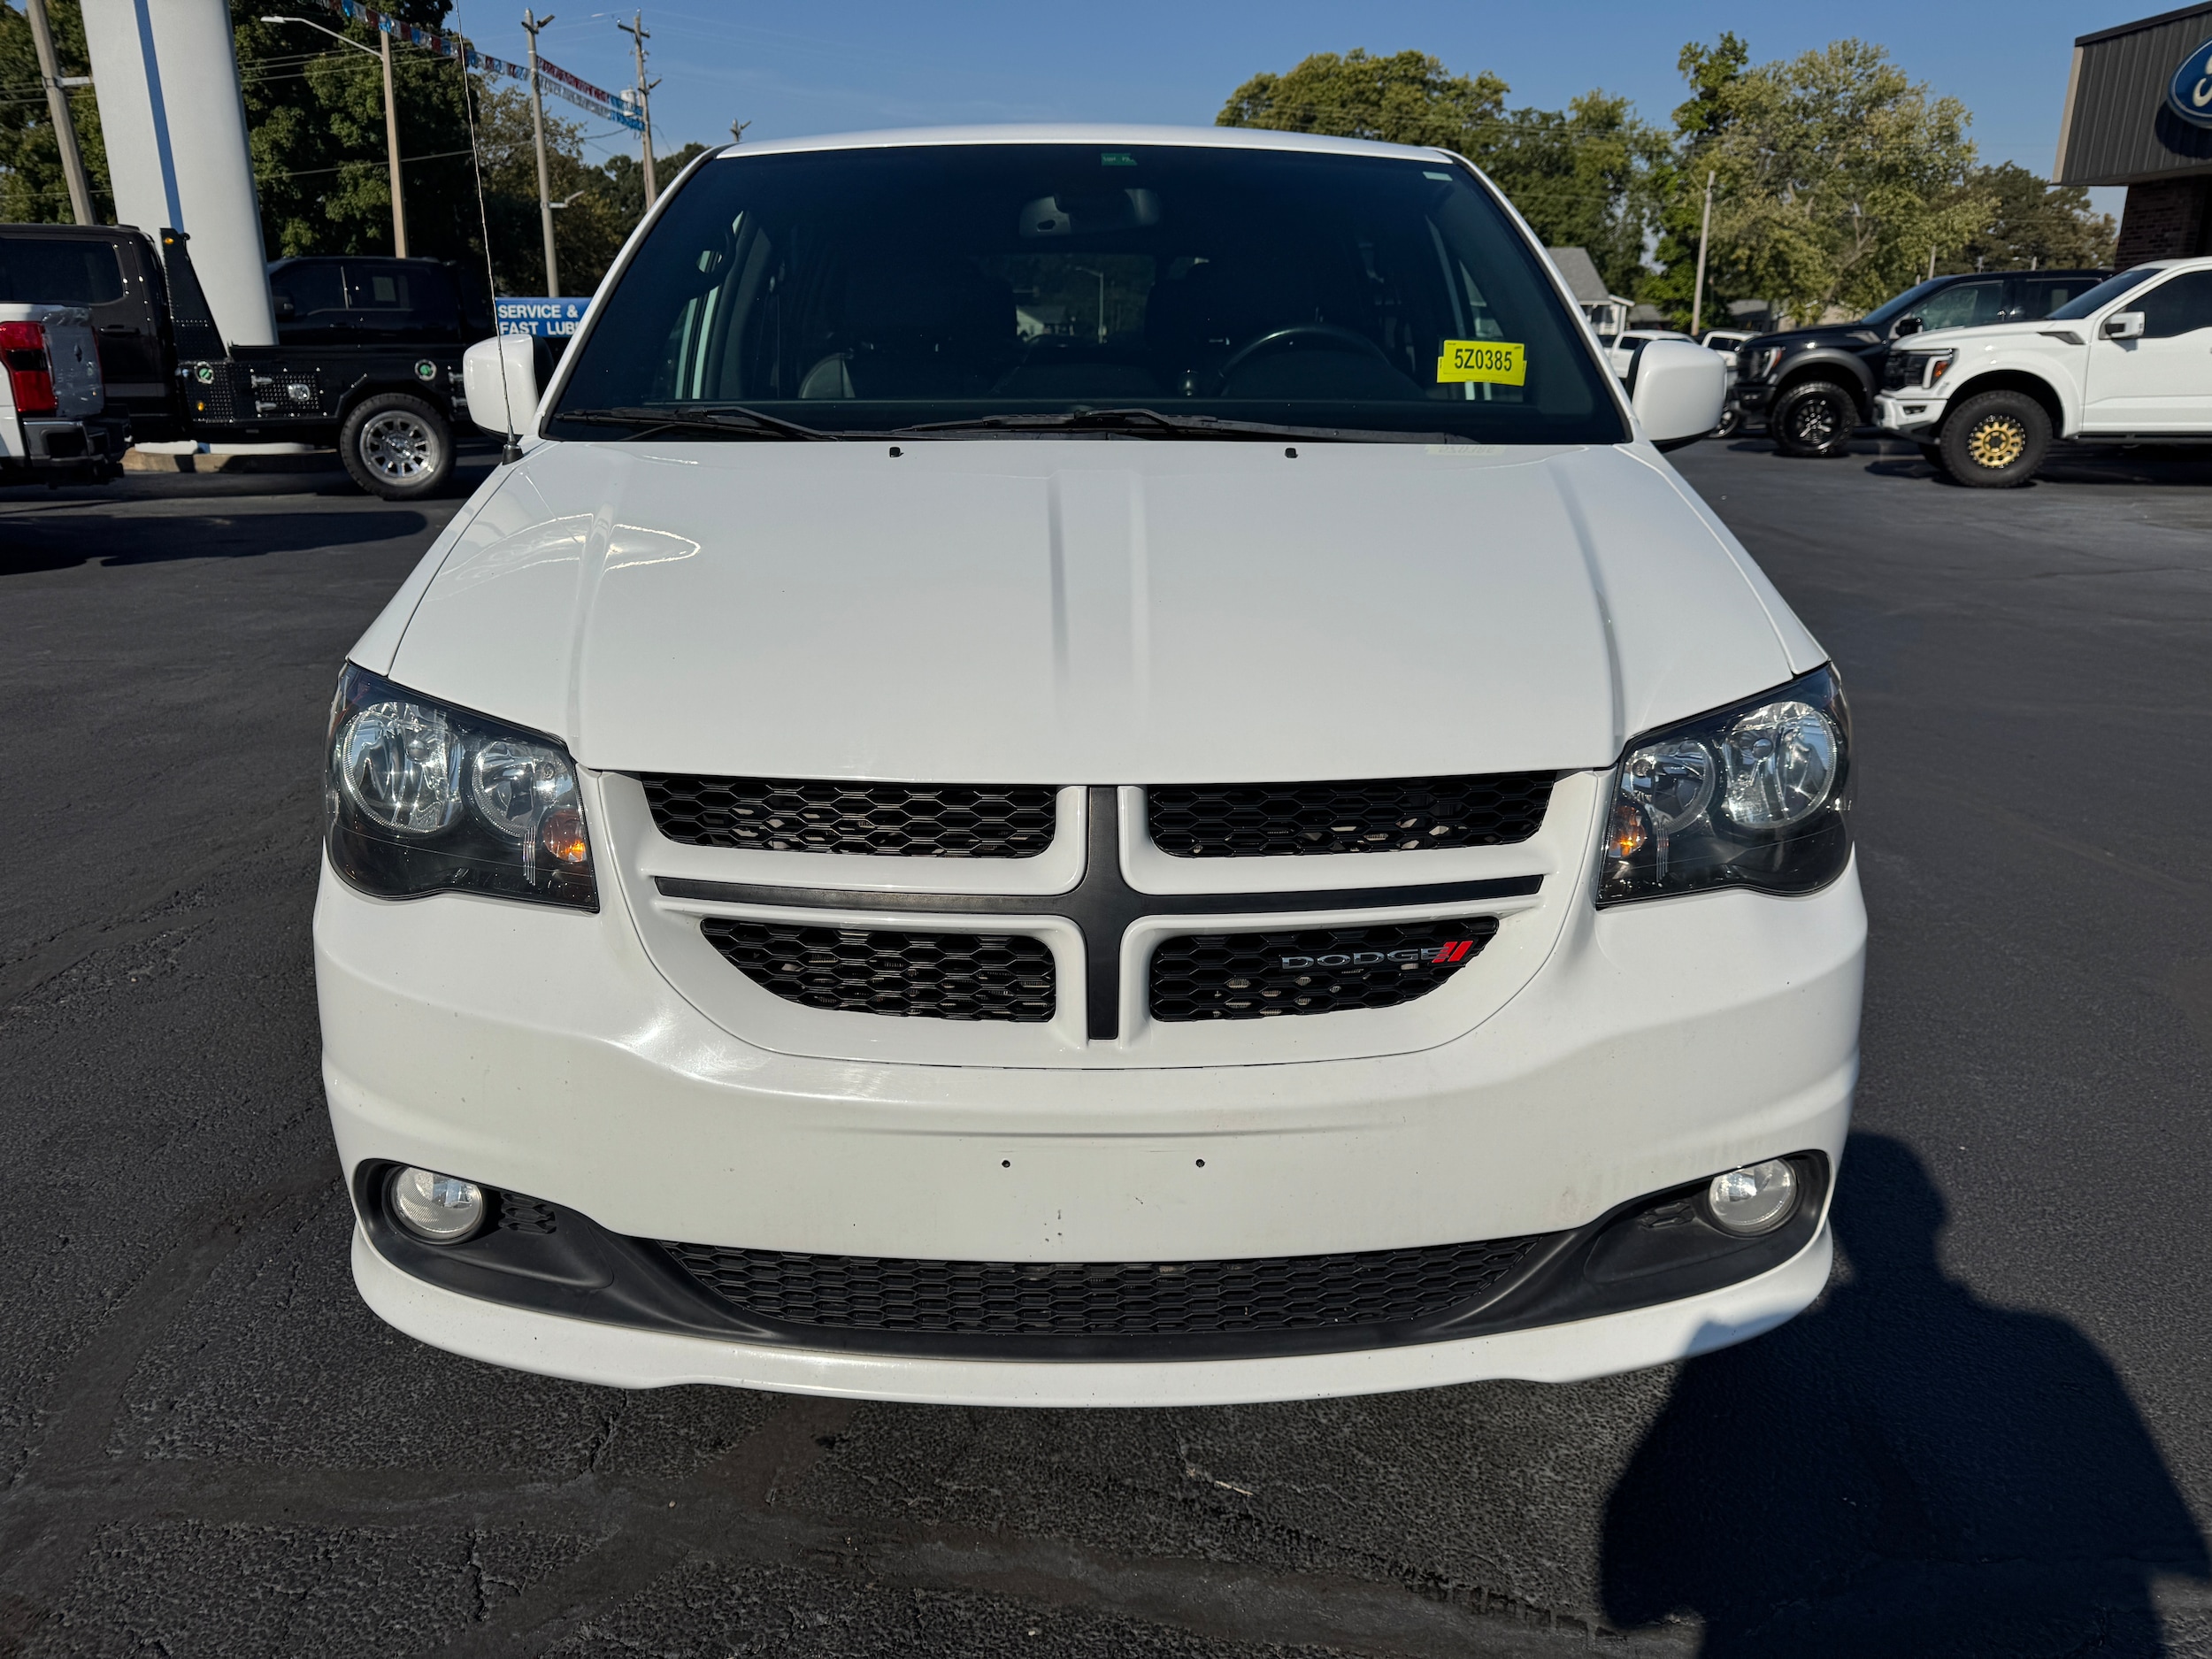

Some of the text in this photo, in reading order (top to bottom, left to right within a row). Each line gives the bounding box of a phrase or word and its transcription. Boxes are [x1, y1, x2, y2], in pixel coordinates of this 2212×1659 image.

[498, 304, 579, 319] SERVICE &
[499, 321, 539, 334] FAST
[1455, 348, 1513, 372] 5Z0385
[1282, 947, 1449, 970] DODGE
